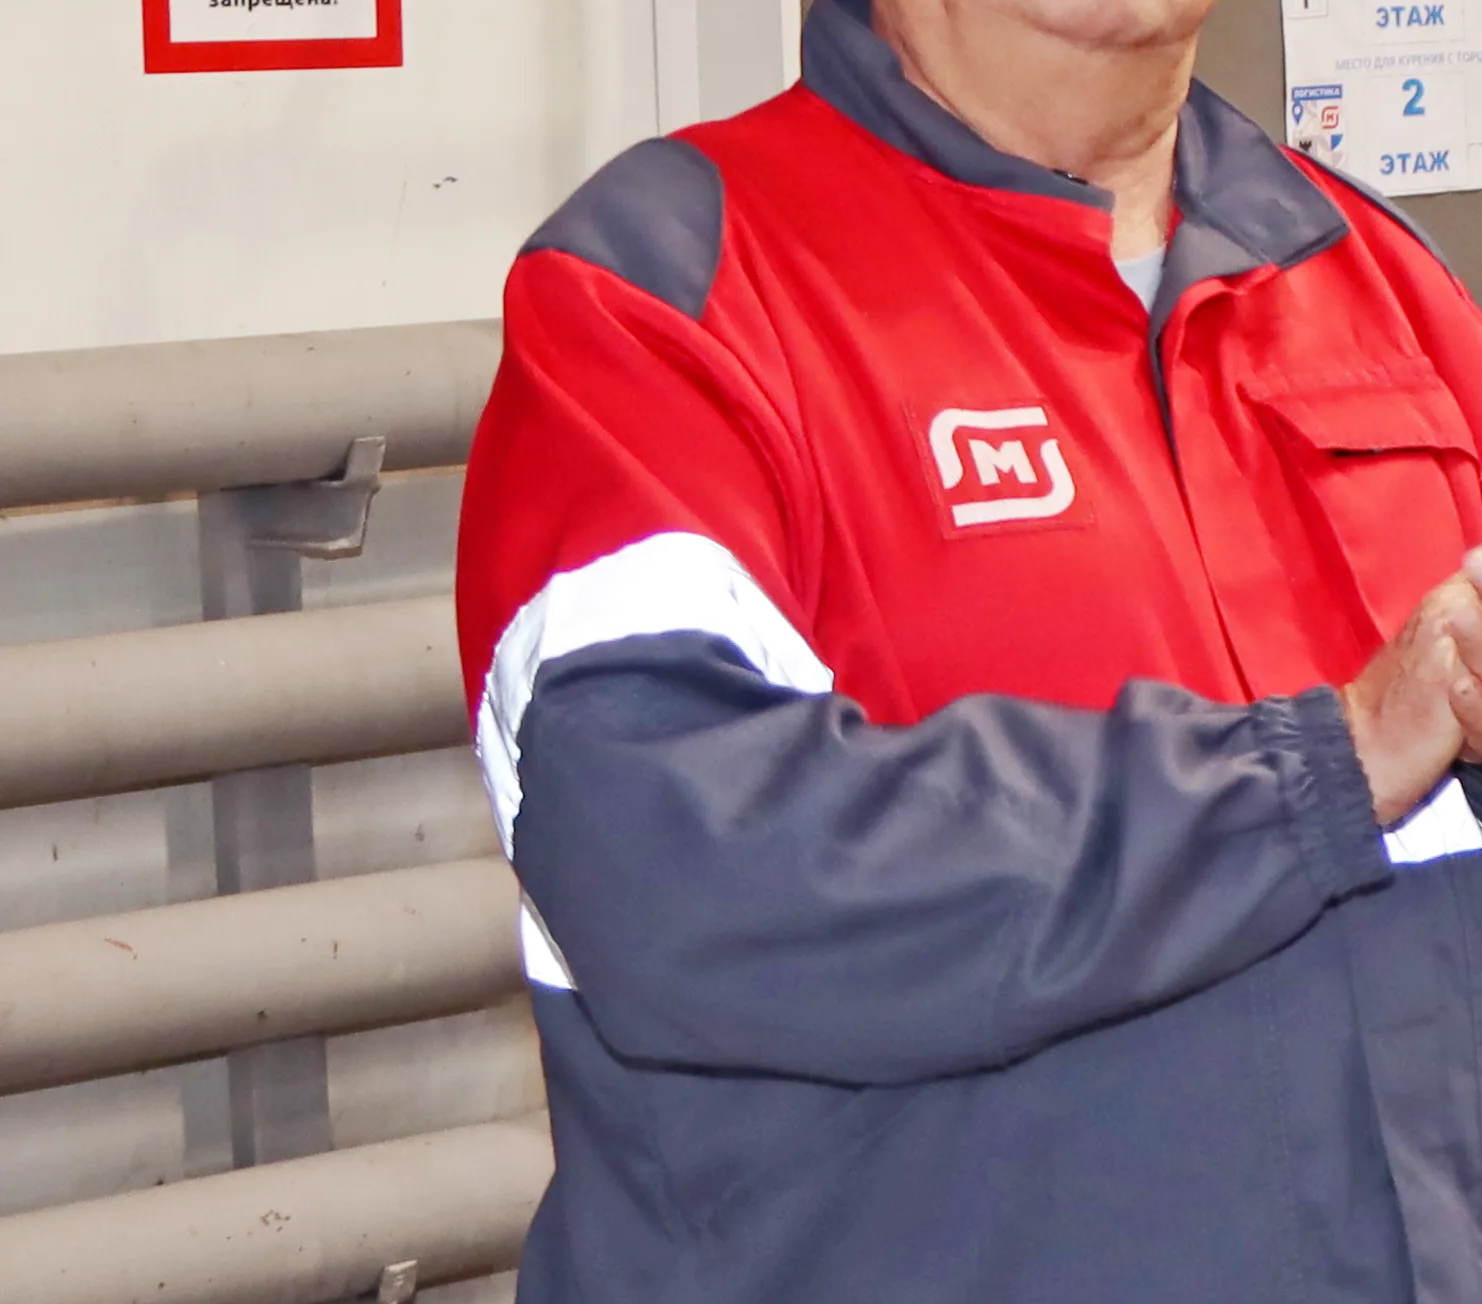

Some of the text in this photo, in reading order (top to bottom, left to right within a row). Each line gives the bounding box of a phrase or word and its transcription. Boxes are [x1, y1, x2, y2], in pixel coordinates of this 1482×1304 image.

[1376, 3, 1445, 29] ЭТАЖ
[1335, 57, 1371, 71] МЕСТО
[1374, 55, 1396, 70] ДЛЯ
[1402, 78, 1425, 117] 2
[1380, 149, 1450, 175] ЭТАЖ
